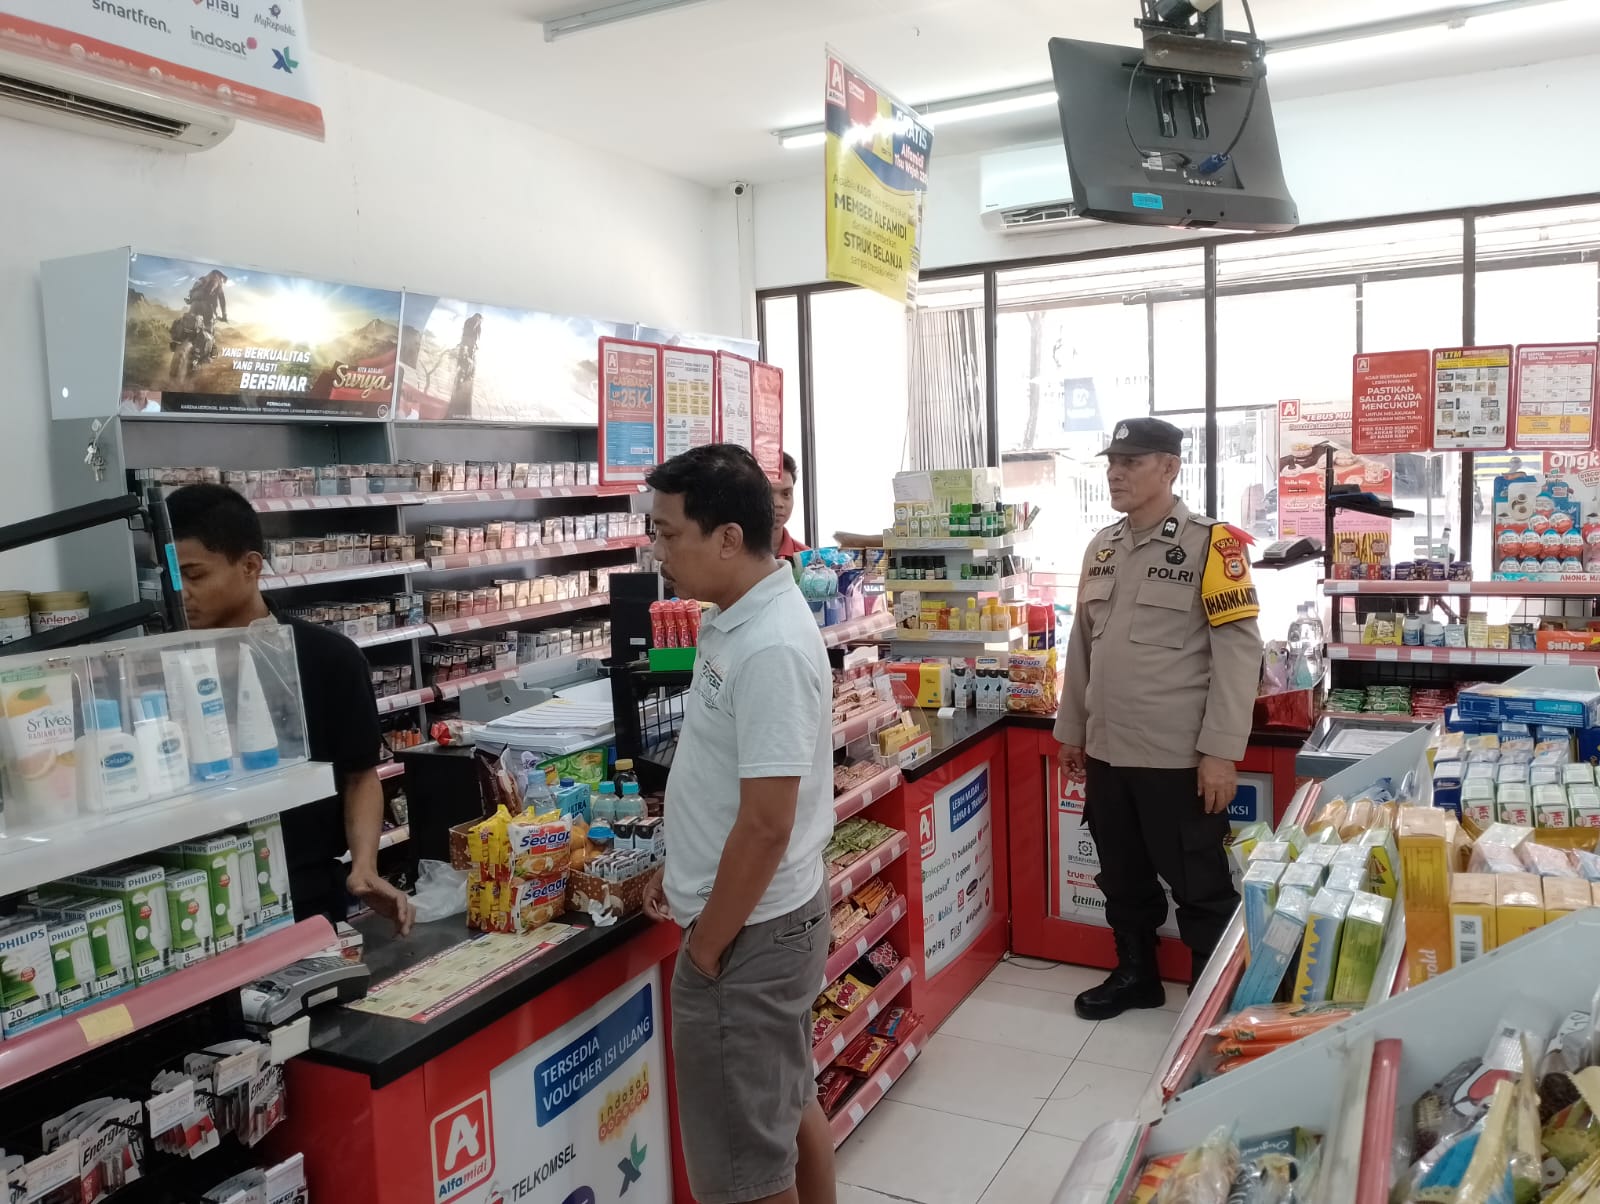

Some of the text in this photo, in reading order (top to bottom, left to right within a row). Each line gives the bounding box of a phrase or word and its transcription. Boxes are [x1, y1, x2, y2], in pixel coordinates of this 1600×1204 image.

[190, 25, 246, 56] indosat
[834, 192, 873, 222] MEMBER
[874, 211, 907, 241] ALFAMIDI
[843, 231, 903, 271] STRUK BELANJA
[221, 347, 311, 364] YANG BERKUALITAS
[232, 360, 278, 373] YANG PASTI
[239, 372, 308, 392] BERSINAR
[1367, 386, 1414, 395] PASTIKAN
[1359, 393, 1422, 403] SALDO ANDA
[1362, 401, 1419, 411] MENCUKUPI
[1306, 413, 1334, 421] TEBUS
[1147, 567, 1194, 583] POLRI
[39, 615, 77, 625] Anlene
[208, 838, 236, 853] PHILIPS
[128, 871, 163, 888] PHILIPS
[176, 873, 207, 889] PHILIPS
[88, 903, 122, 920] PHILIPS
[0, 928, 45, 952] PHILIPS
[51, 924, 86, 942] PHILIPS
[10, 1008, 23, 1021] 20
[540, 1034, 600, 1088] TERSEDIA
[542, 1014, 651, 1112] VOUCHER ISI ULANG
[438, 1158, 488, 1198] Alfamidi
[511, 1142, 577, 1203] TELKOMSEL
